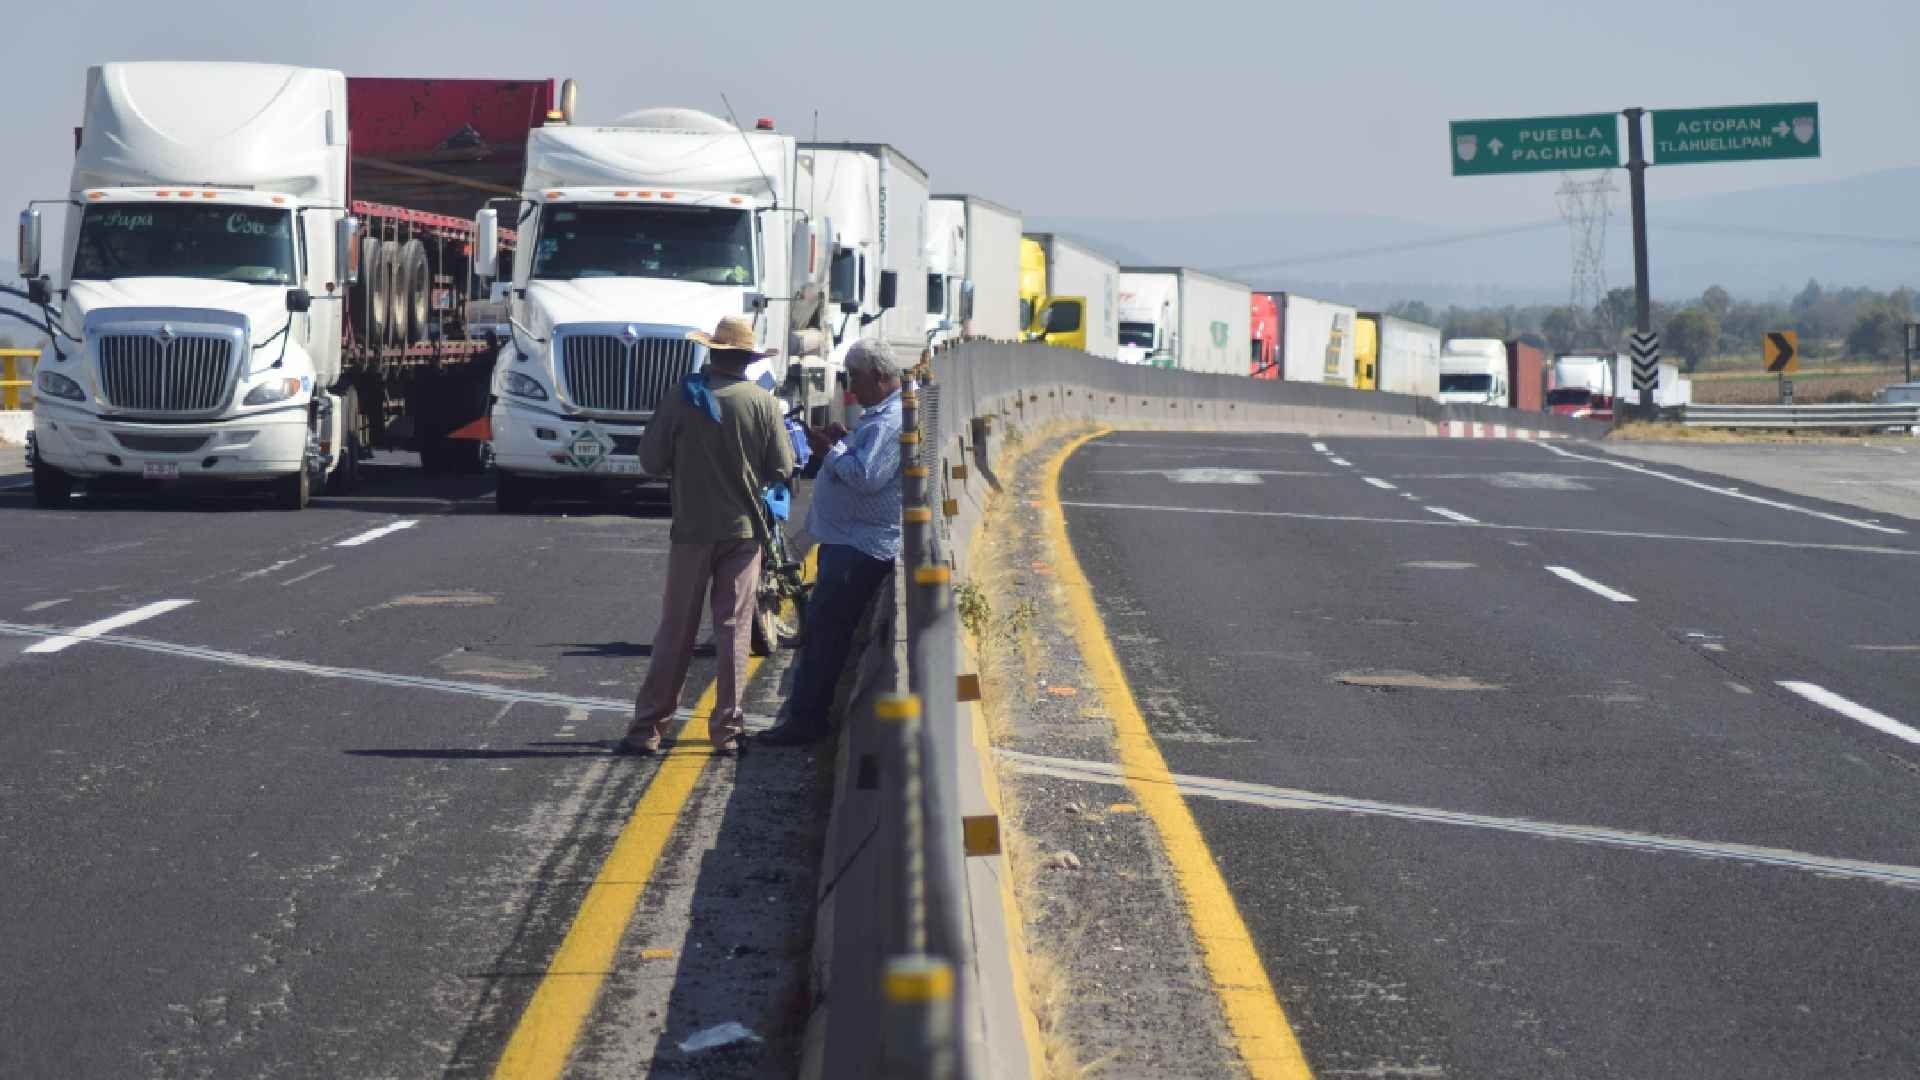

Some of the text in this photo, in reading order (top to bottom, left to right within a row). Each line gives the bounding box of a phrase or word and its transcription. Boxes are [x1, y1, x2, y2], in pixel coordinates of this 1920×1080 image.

[1676, 118, 1761, 134] ACTOPAN
[1519, 127, 1603, 144] PUEBLA
[1659, 136, 1773, 152] TLAHUELILPAN
[1511, 144, 1613, 161] PACHUCA
